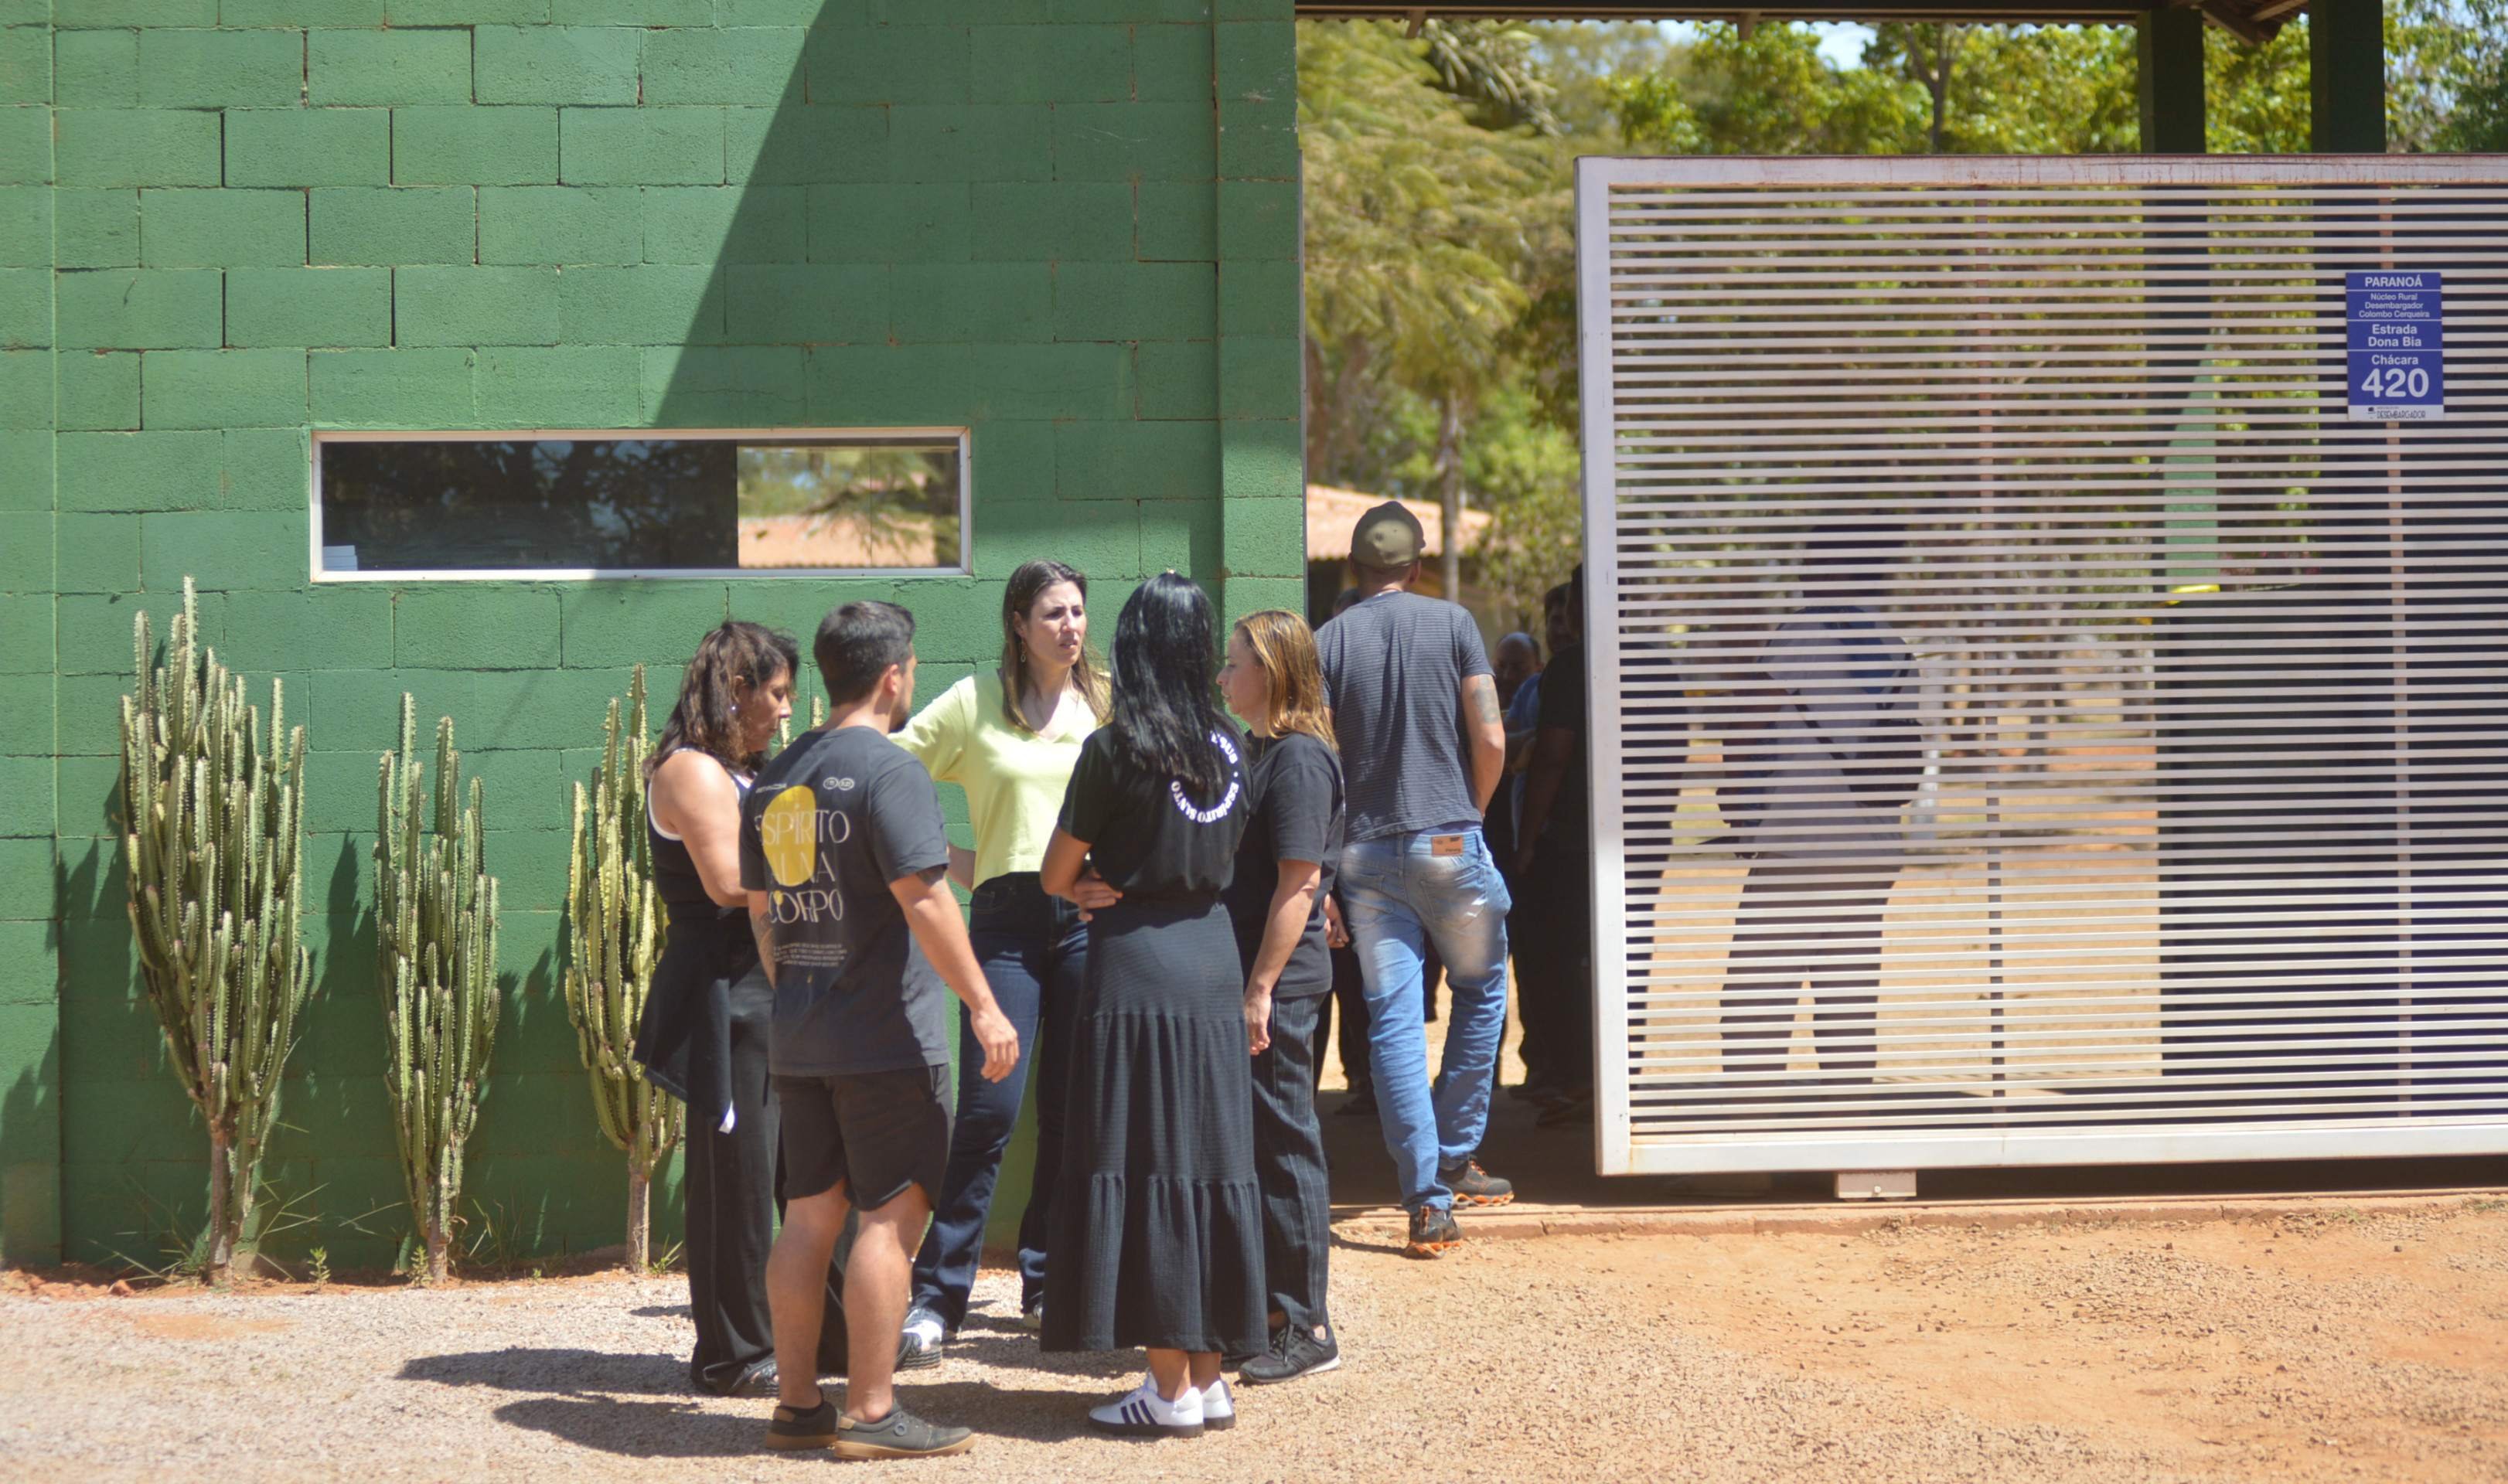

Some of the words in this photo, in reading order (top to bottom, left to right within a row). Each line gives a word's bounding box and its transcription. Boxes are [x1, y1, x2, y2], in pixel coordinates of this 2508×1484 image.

[2364, 274, 2423, 288] PARANOÁ
[2370, 292, 2397, 301] Núcleo
[2364, 301, 2424, 310] Desembargador
[2394, 310, 2430, 319] Cerqueira
[2372, 324, 2418, 335] Estrada
[2368, 336, 2399, 347] Dona
[2402, 336, 2422, 347] Bia
[2371, 355, 2419, 365] Chácara
[2361, 367, 2430, 399] 420
